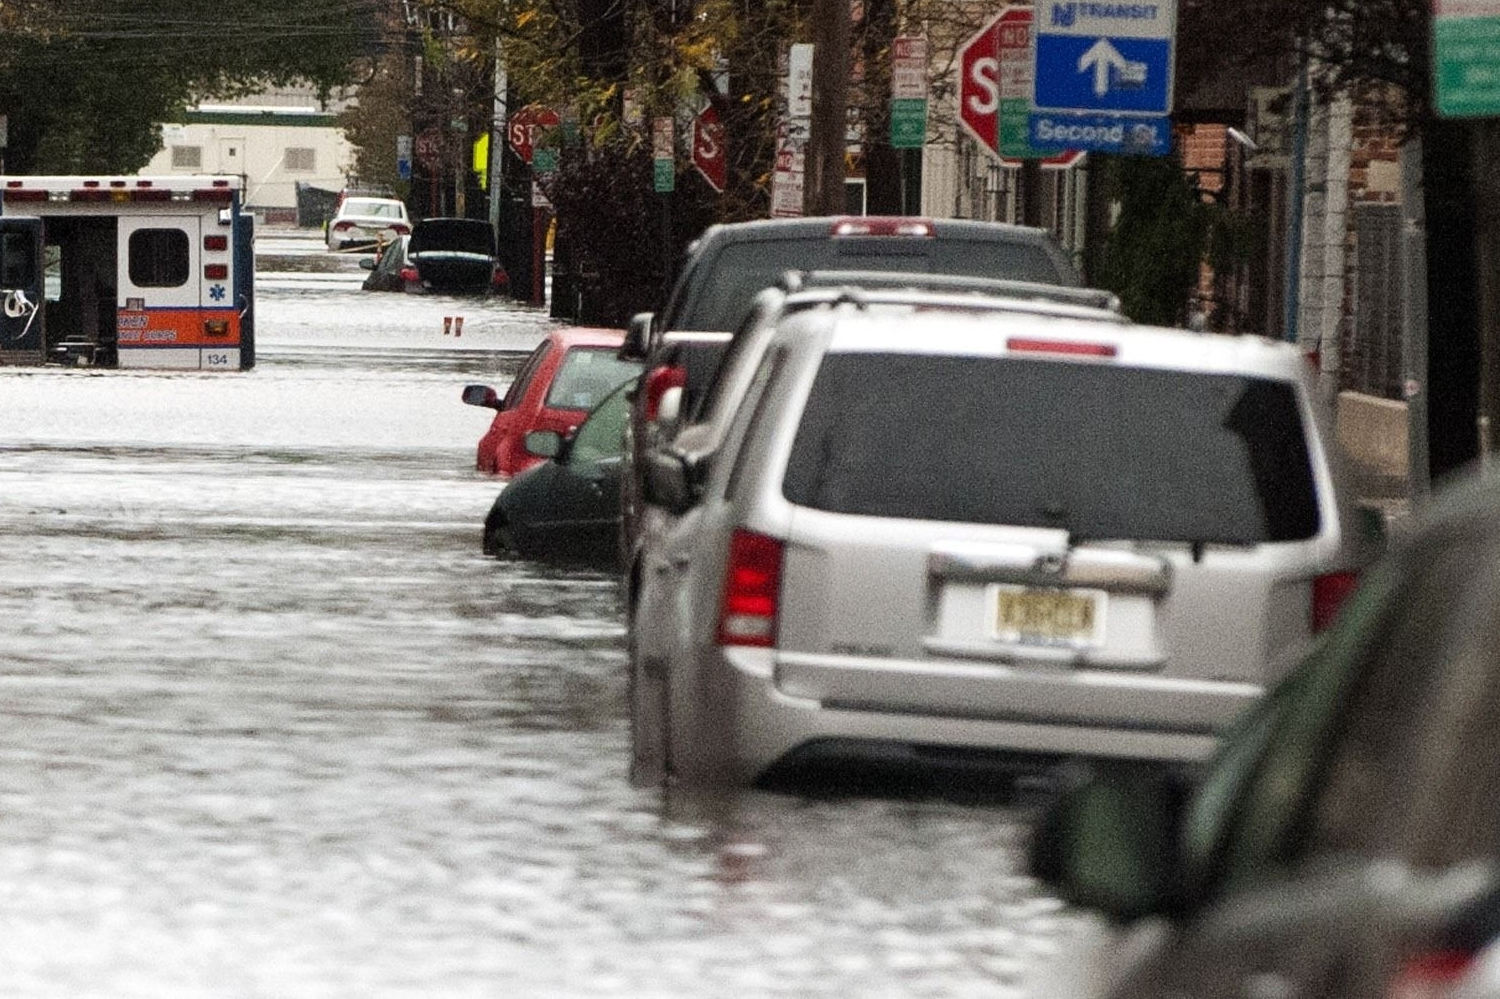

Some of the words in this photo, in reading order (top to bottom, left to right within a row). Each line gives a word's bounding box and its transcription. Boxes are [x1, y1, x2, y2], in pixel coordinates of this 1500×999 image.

[1079, 3, 1157, 20] TRANSIT
[1038, 119, 1124, 143] Second
[207, 354, 228, 365] 134
